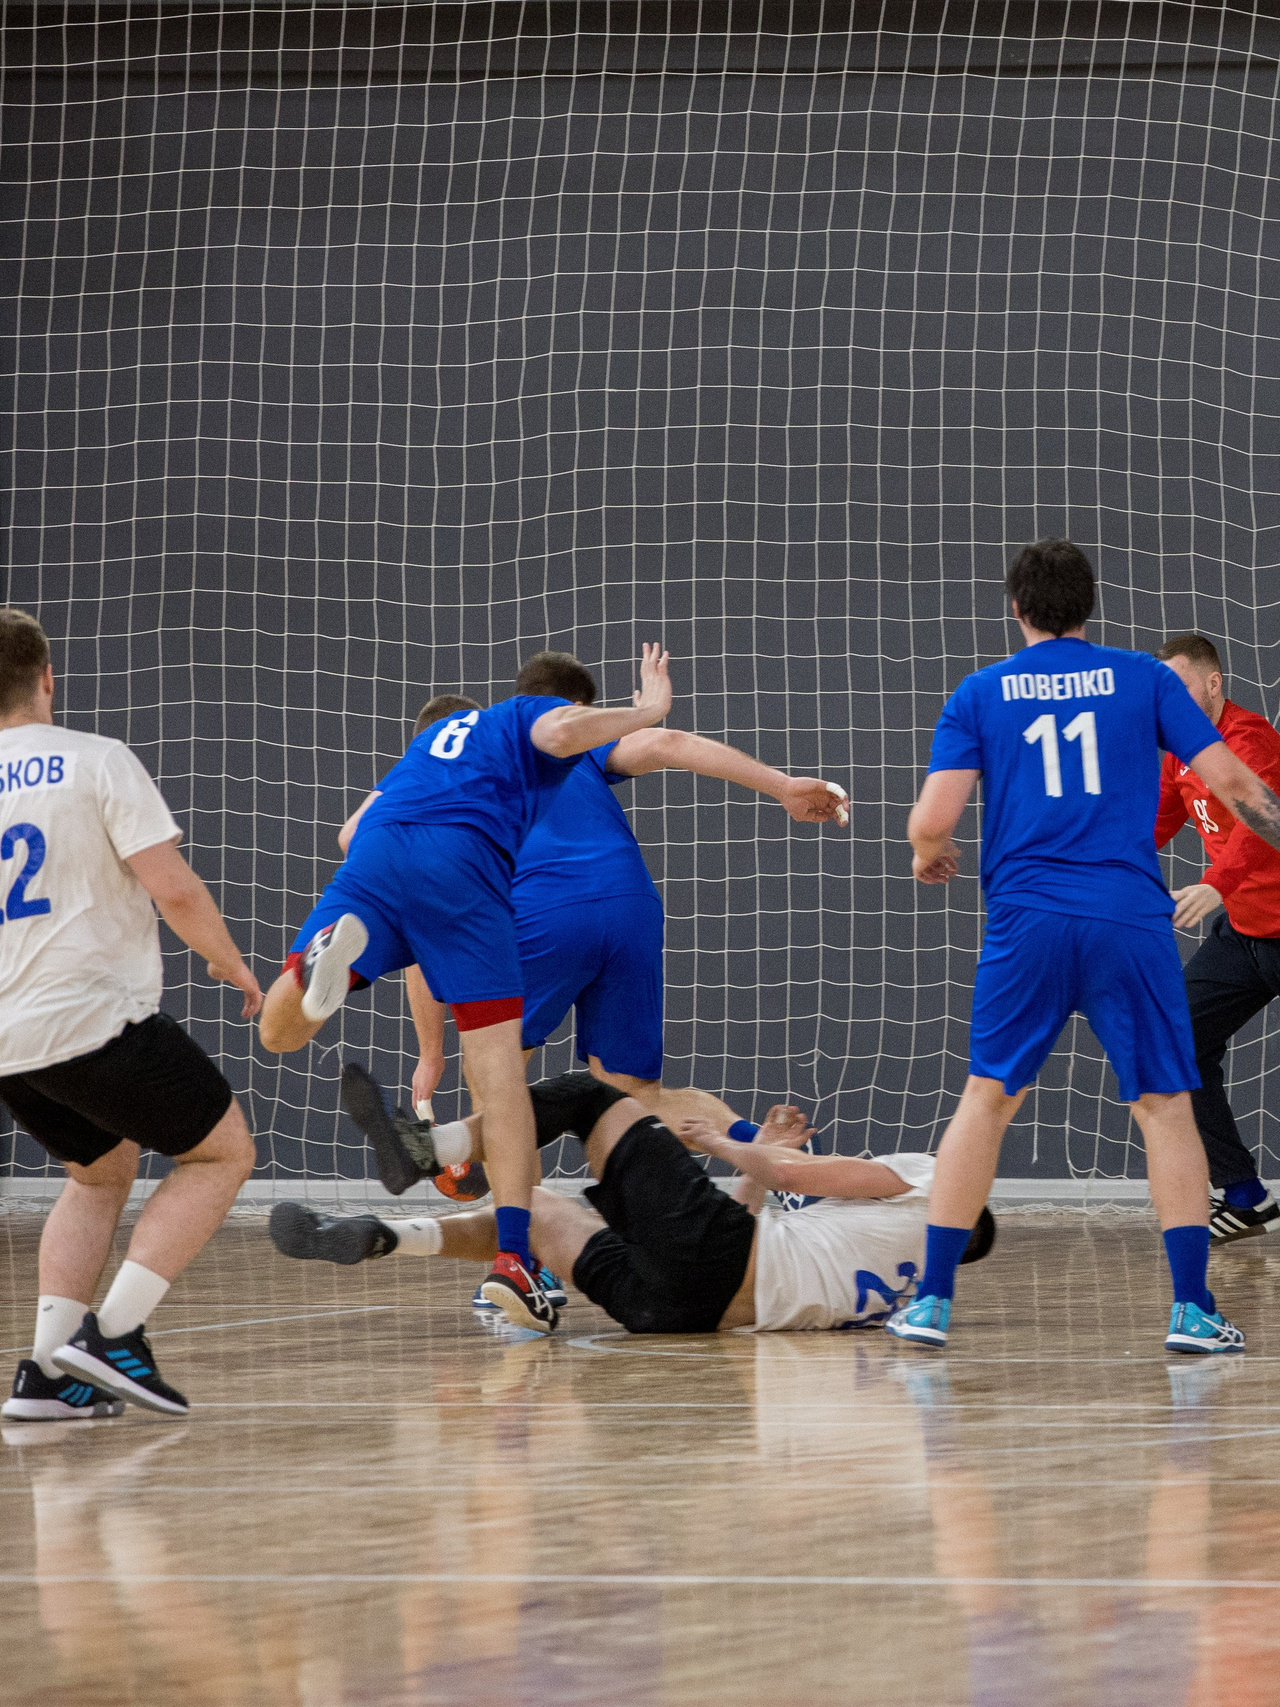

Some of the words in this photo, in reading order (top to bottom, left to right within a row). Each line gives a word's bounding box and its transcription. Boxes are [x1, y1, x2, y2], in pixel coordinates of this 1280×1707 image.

[1001, 667, 1116, 702] ПОВЕЛКО
[1022, 711, 1102, 798] 11
[0, 823, 51, 926] 2
